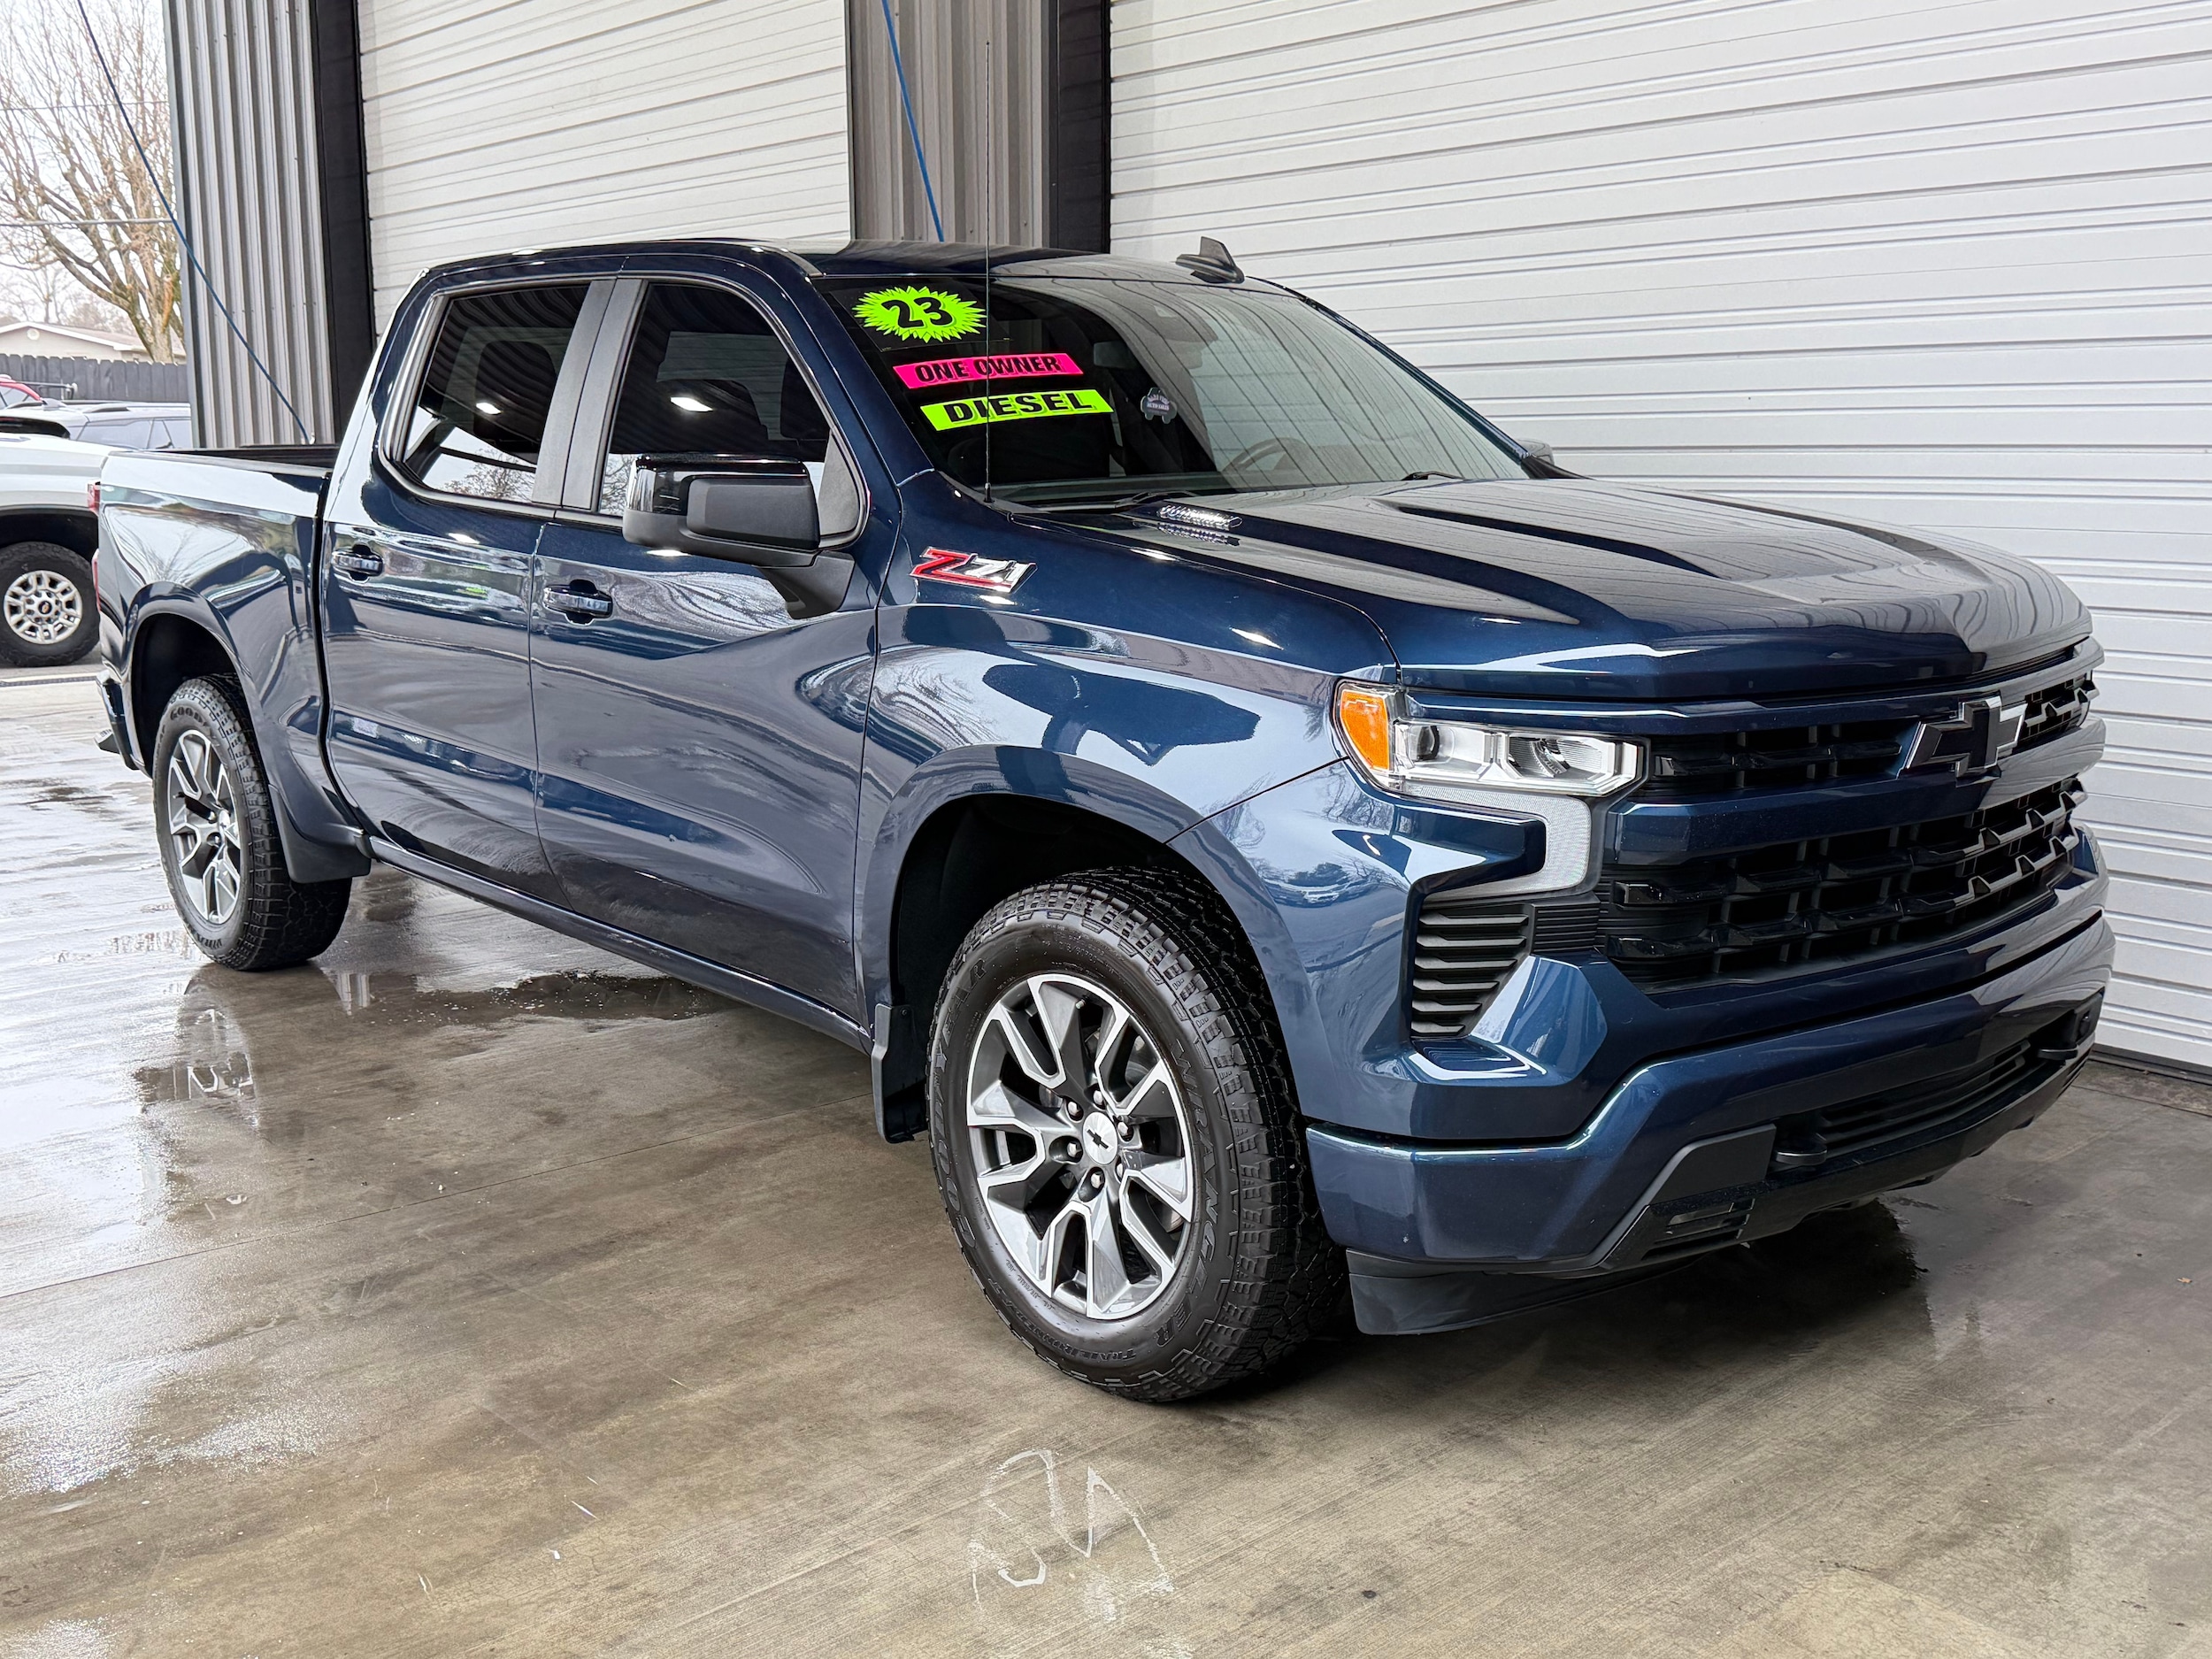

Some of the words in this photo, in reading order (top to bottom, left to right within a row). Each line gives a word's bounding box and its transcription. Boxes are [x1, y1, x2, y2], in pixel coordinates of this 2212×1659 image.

[881, 296, 956, 328] 23
[915, 361, 970, 382] ONE
[974, 356, 1062, 377] OWNER
[943, 393, 1094, 423] DIESEL
[909, 546, 1038, 594] Z71
[934, 958, 988, 1248] GOODYEAR
[1154, 1038, 1218, 1348] WRANGLER
